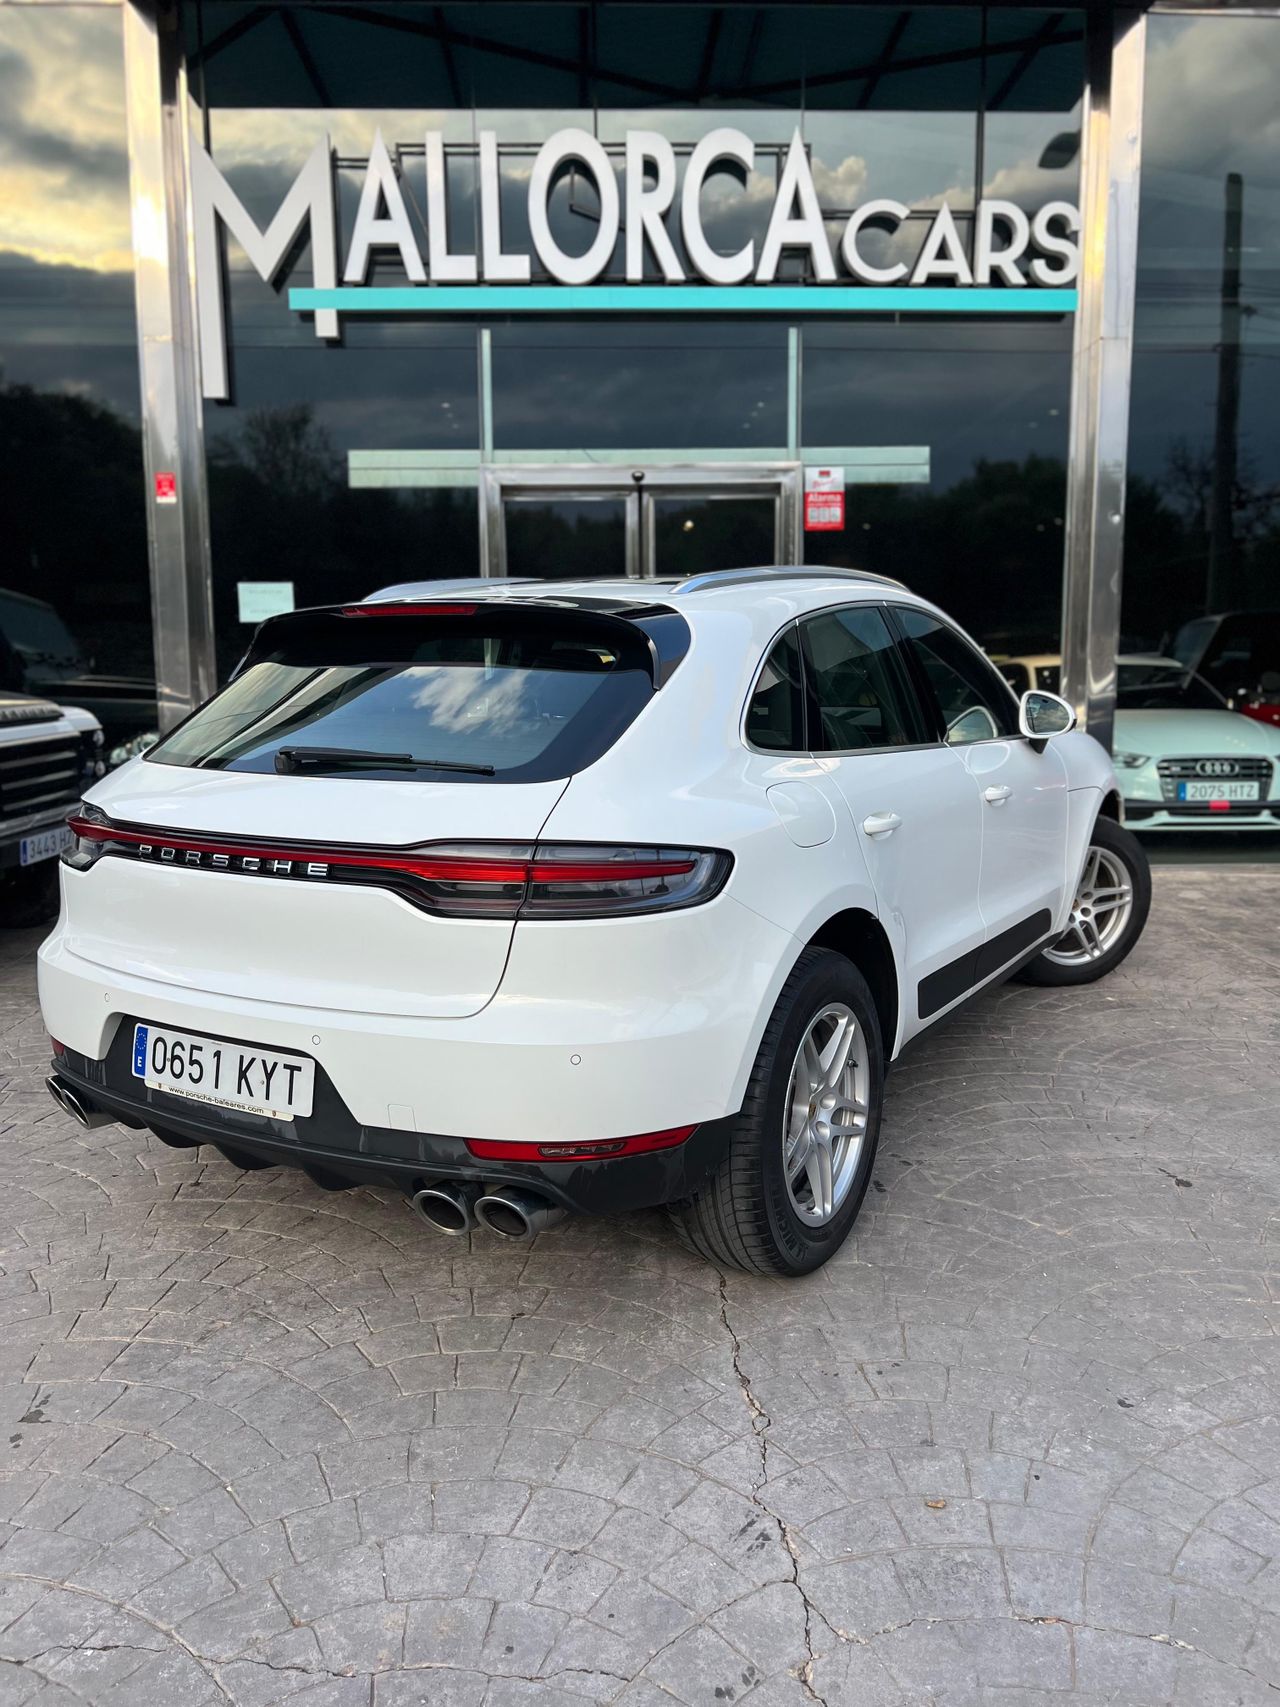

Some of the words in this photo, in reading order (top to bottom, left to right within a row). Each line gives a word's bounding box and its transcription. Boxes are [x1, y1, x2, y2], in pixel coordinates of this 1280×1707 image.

[190, 127, 837, 399] MALLORCA
[842, 199, 1081, 286] CARS
[1190, 784, 1225, 799] 2075
[1229, 784, 1255, 799] HTZ
[30, 834, 57, 858] 3443
[139, 844, 328, 876] PORSCHE
[151, 1036, 222, 1090] 0651
[237, 1054, 302, 1105] KYT
[168, 1086, 264, 1114] www.porsche-baleares.com
